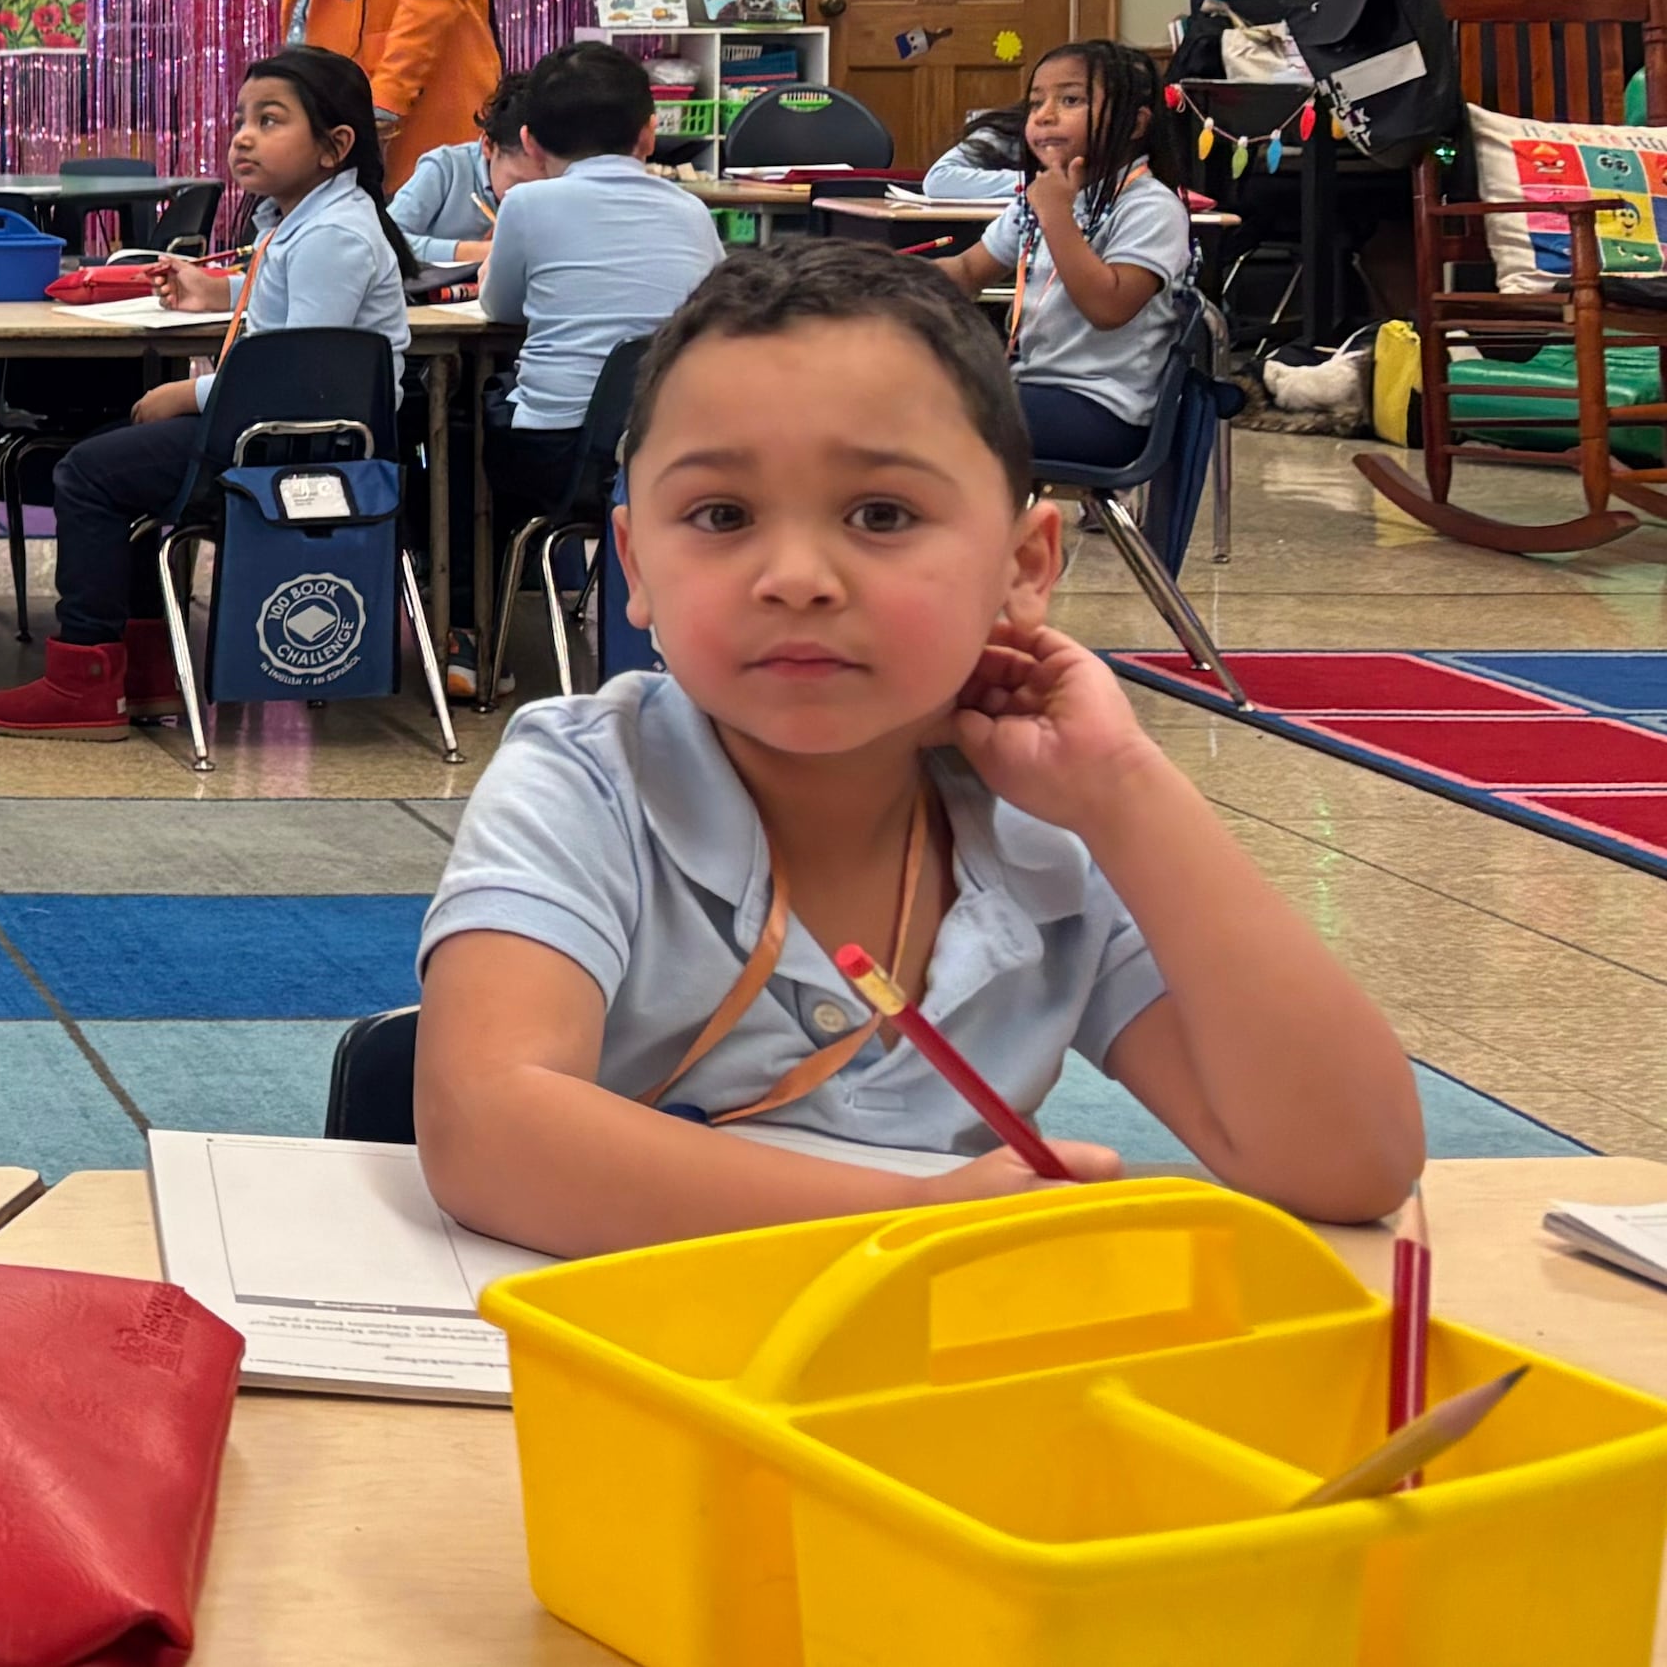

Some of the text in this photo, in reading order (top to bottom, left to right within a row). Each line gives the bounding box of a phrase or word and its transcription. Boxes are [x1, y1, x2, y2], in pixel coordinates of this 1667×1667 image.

[266, 580, 340, 621] 100 BOOK
[276, 617, 355, 666] CHALLENGE
[267, 667, 303, 686] ENGLISH
